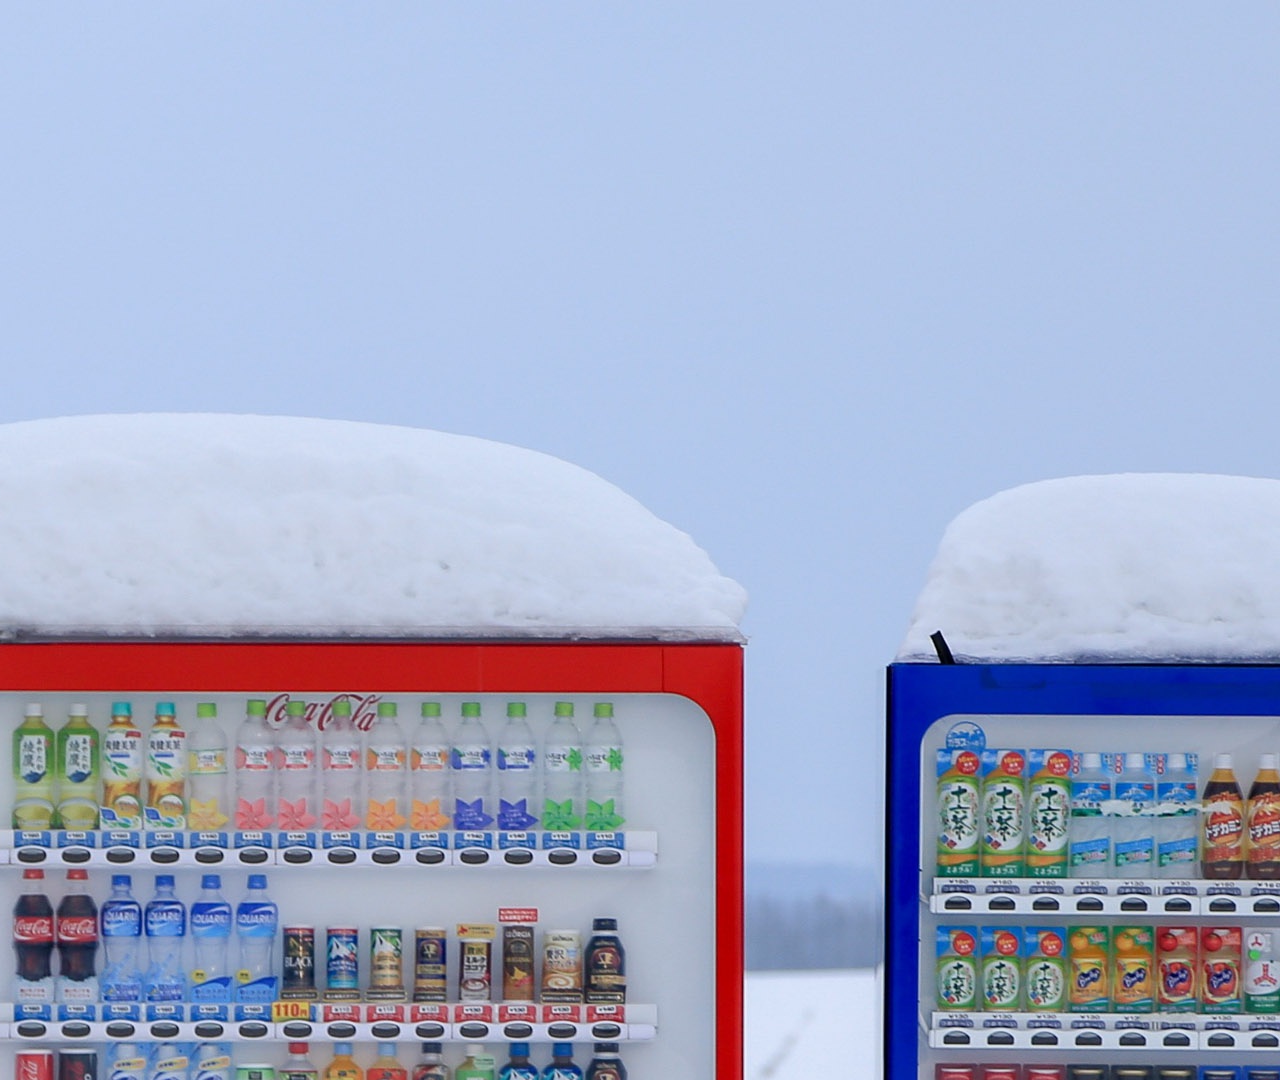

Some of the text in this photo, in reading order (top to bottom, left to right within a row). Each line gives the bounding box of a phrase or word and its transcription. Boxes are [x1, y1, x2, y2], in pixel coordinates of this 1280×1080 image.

[265, 694, 383, 731] Coa-Cla
[949, 785, 976, 841] 十六茶
[994, 787, 1021, 841] 十六茶
[1038, 787, 1066, 842] 十六茶
[16, 919, 50, 935] Coca-Cola
[60, 919, 95, 935] Coca-Cola
[285, 956, 312, 968] BLACK
